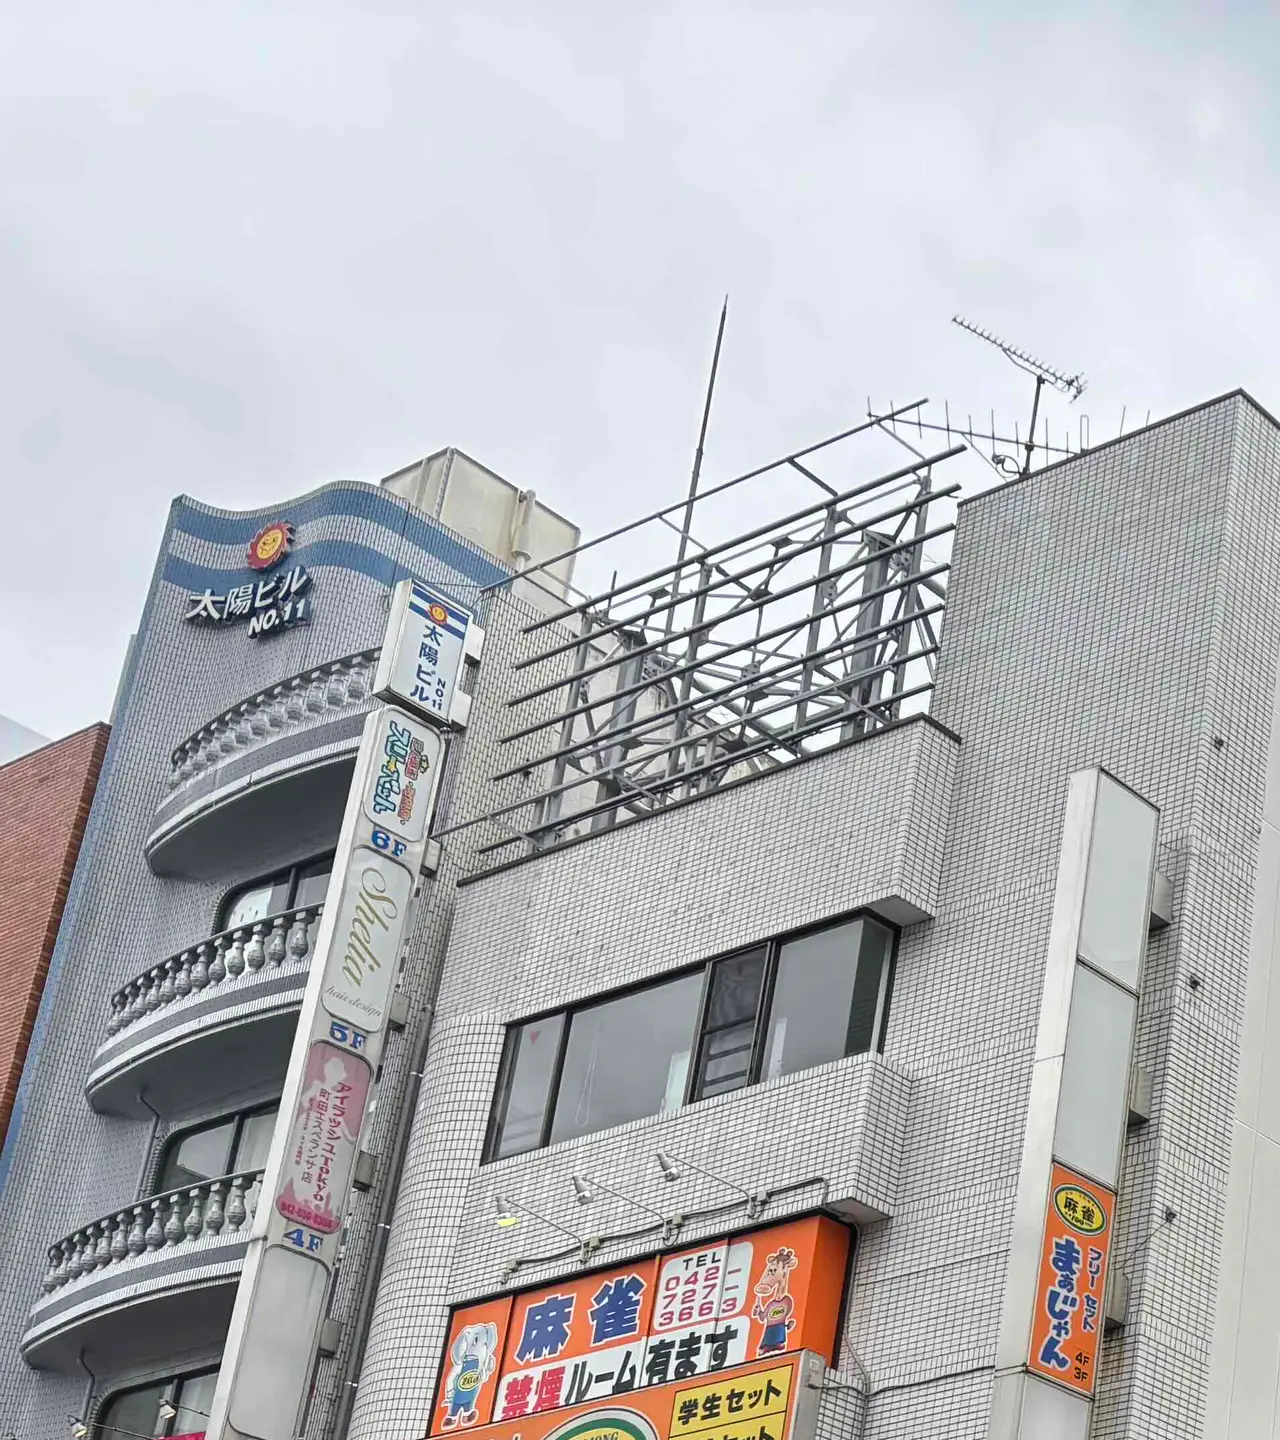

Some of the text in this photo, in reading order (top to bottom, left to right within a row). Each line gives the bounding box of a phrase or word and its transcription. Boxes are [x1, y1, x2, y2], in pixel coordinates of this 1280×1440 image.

[185, 566, 310, 621] 太陽ビル
[249, 600, 305, 637] NO.11
[411, 624, 444, 701] 太陽ビル
[371, 829, 407, 857] 6F
[329, 1020, 366, 1050] 5F
[1063, 1197, 1095, 1225] 麻雀
[283, 1228, 324, 1252] 4F
[683, 1252, 722, 1267] TEL
[666, 1267, 742, 1291] 042-
[1083, 1248, 1102, 1331] フリー セット
[662, 1285, 738, 1309] 727-
[1041, 1238, 1079, 1368] まぁじゃん
[518, 1275, 646, 1359] 麻雀
[660, 1299, 737, 1326] 3663
[1075, 1352, 1090, 1367] 4F
[1074, 1367, 1089, 1382] 3F
[679, 1381, 781, 1426] 学生セット
